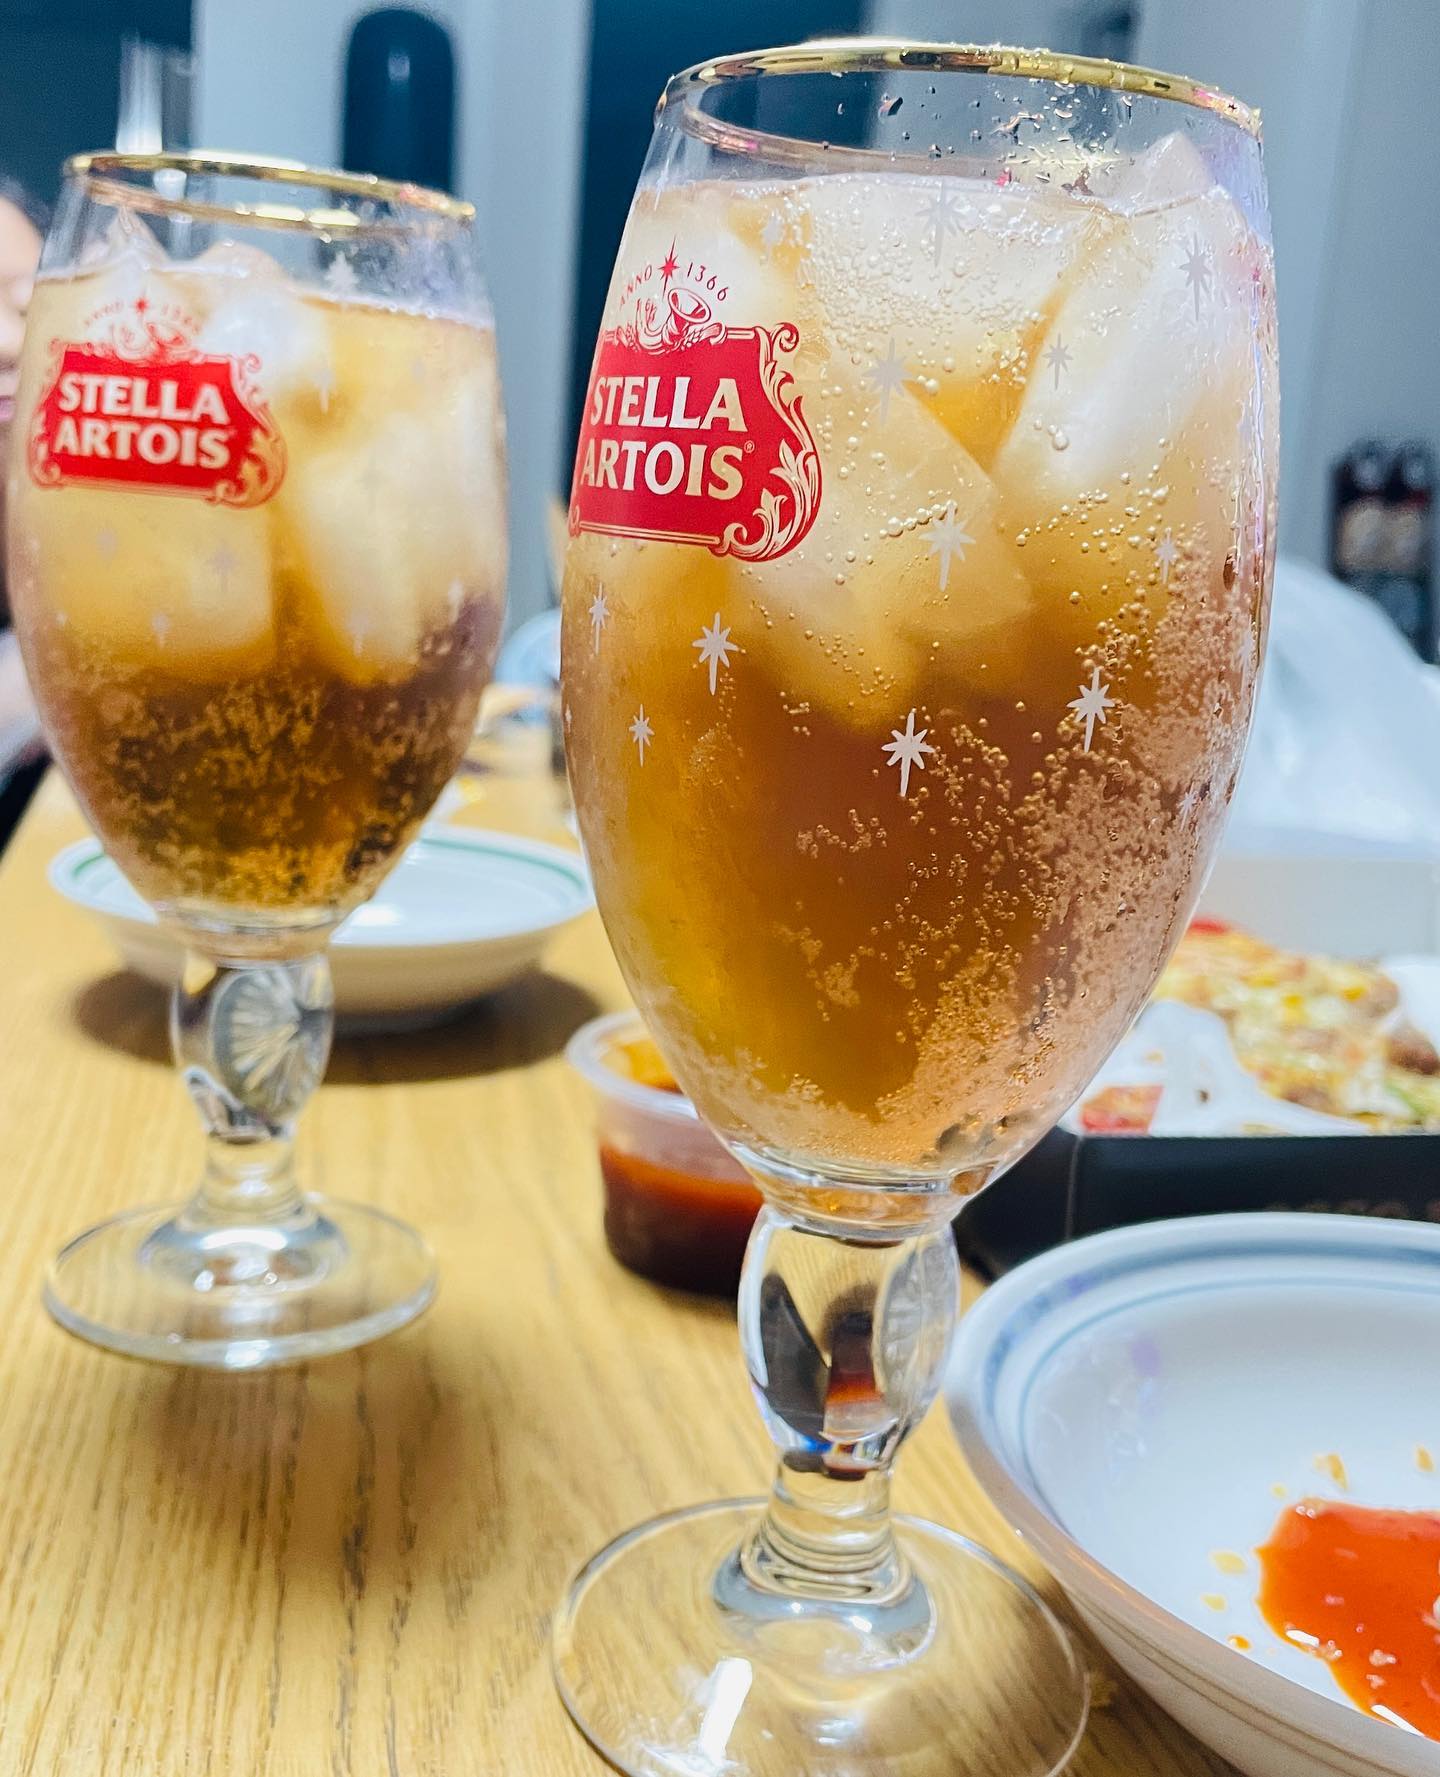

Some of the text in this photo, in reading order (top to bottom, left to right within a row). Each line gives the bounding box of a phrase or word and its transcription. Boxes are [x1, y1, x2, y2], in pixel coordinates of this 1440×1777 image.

[687, 262, 729, 301] 1366
[58, 371, 230, 425] STELLA
[590, 376, 748, 432] STELLA
[54, 416, 231, 470] ARTOIS
[579, 438, 744, 500] ARTOIS
